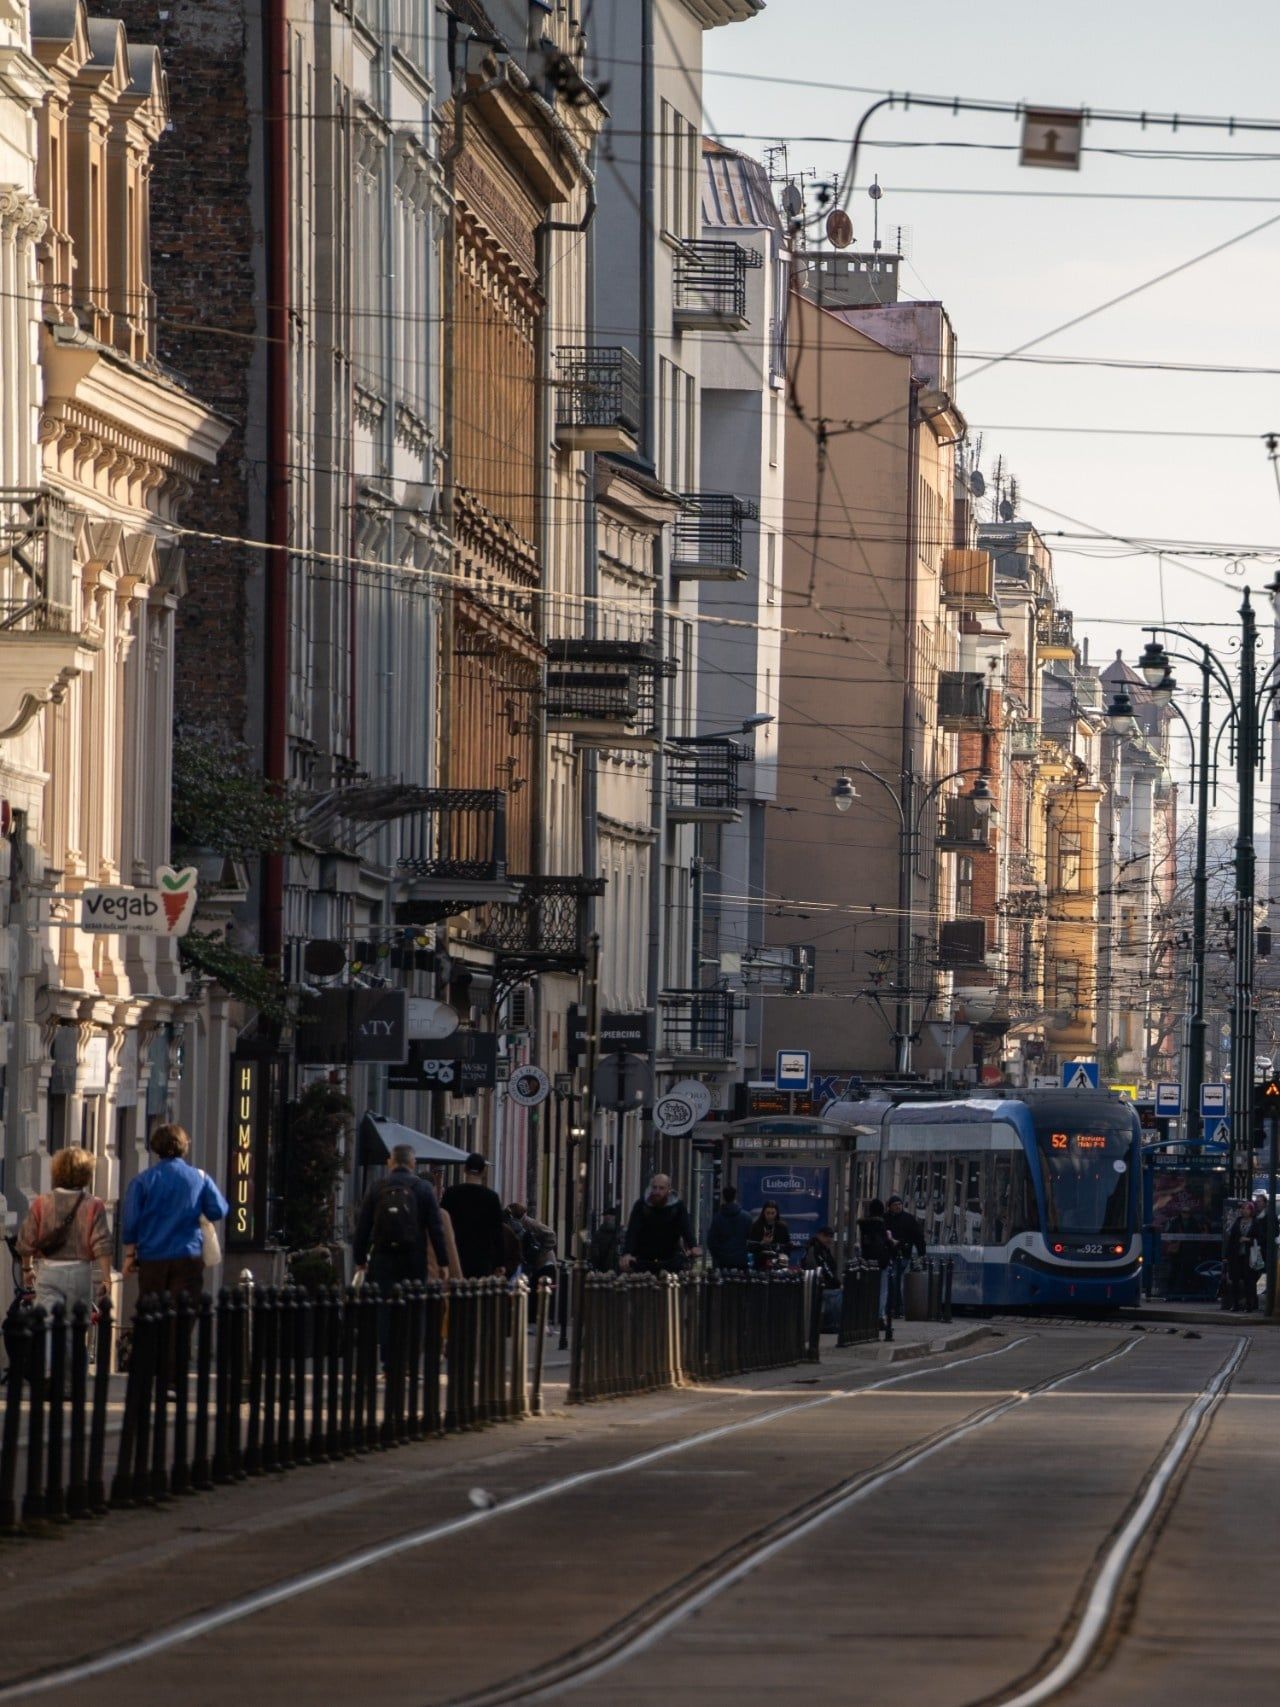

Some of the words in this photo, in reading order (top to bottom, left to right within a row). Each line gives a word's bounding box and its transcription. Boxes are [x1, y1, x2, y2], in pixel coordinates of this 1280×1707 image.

[1051, 1133, 1067, 1149] 52
[237, 1068, 251, 1232] HUMMUS
[766, 1179, 801, 1188] Lubella
[1085, 1244, 1103, 1254] 922
